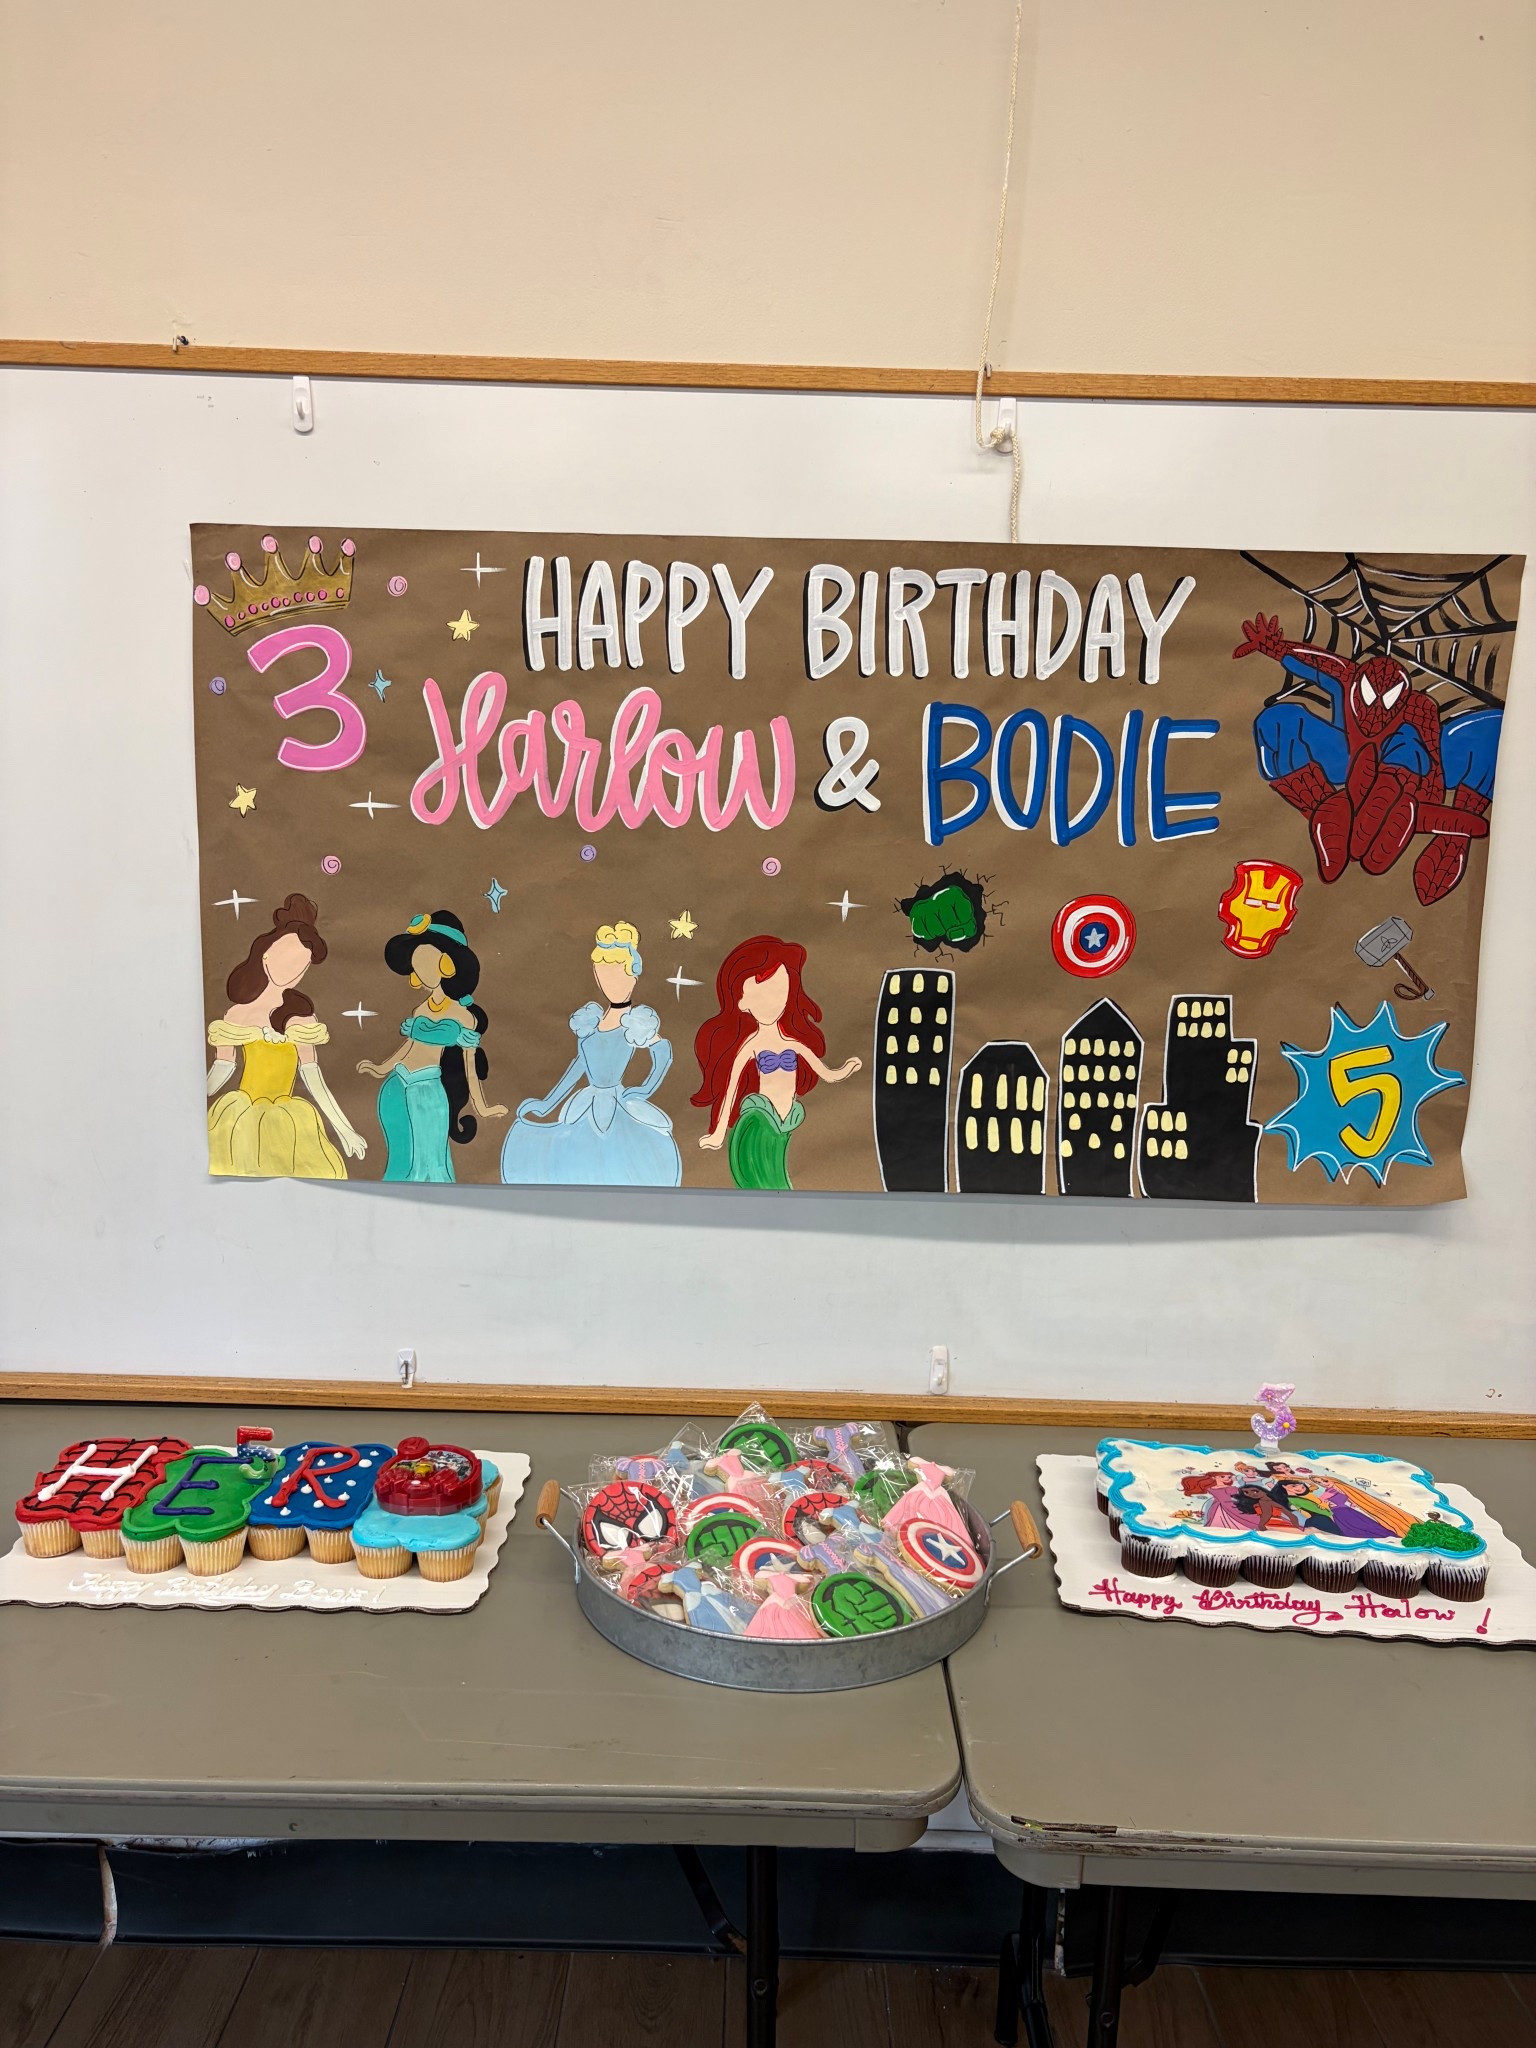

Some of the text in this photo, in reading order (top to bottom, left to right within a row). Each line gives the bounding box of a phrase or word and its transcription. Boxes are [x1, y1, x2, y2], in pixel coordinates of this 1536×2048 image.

[524, 556, 1196, 685] HAPPY BIRTHDAY
[247, 624, 367, 771] 3
[411, 672, 1221, 846] Harlow & BODIE
[1329, 1045, 1402, 1158] 5
[236, 1425, 278, 1480] 5
[1251, 1382, 1297, 1442] 3
[1088, 1577, 1183, 1614] Happy
